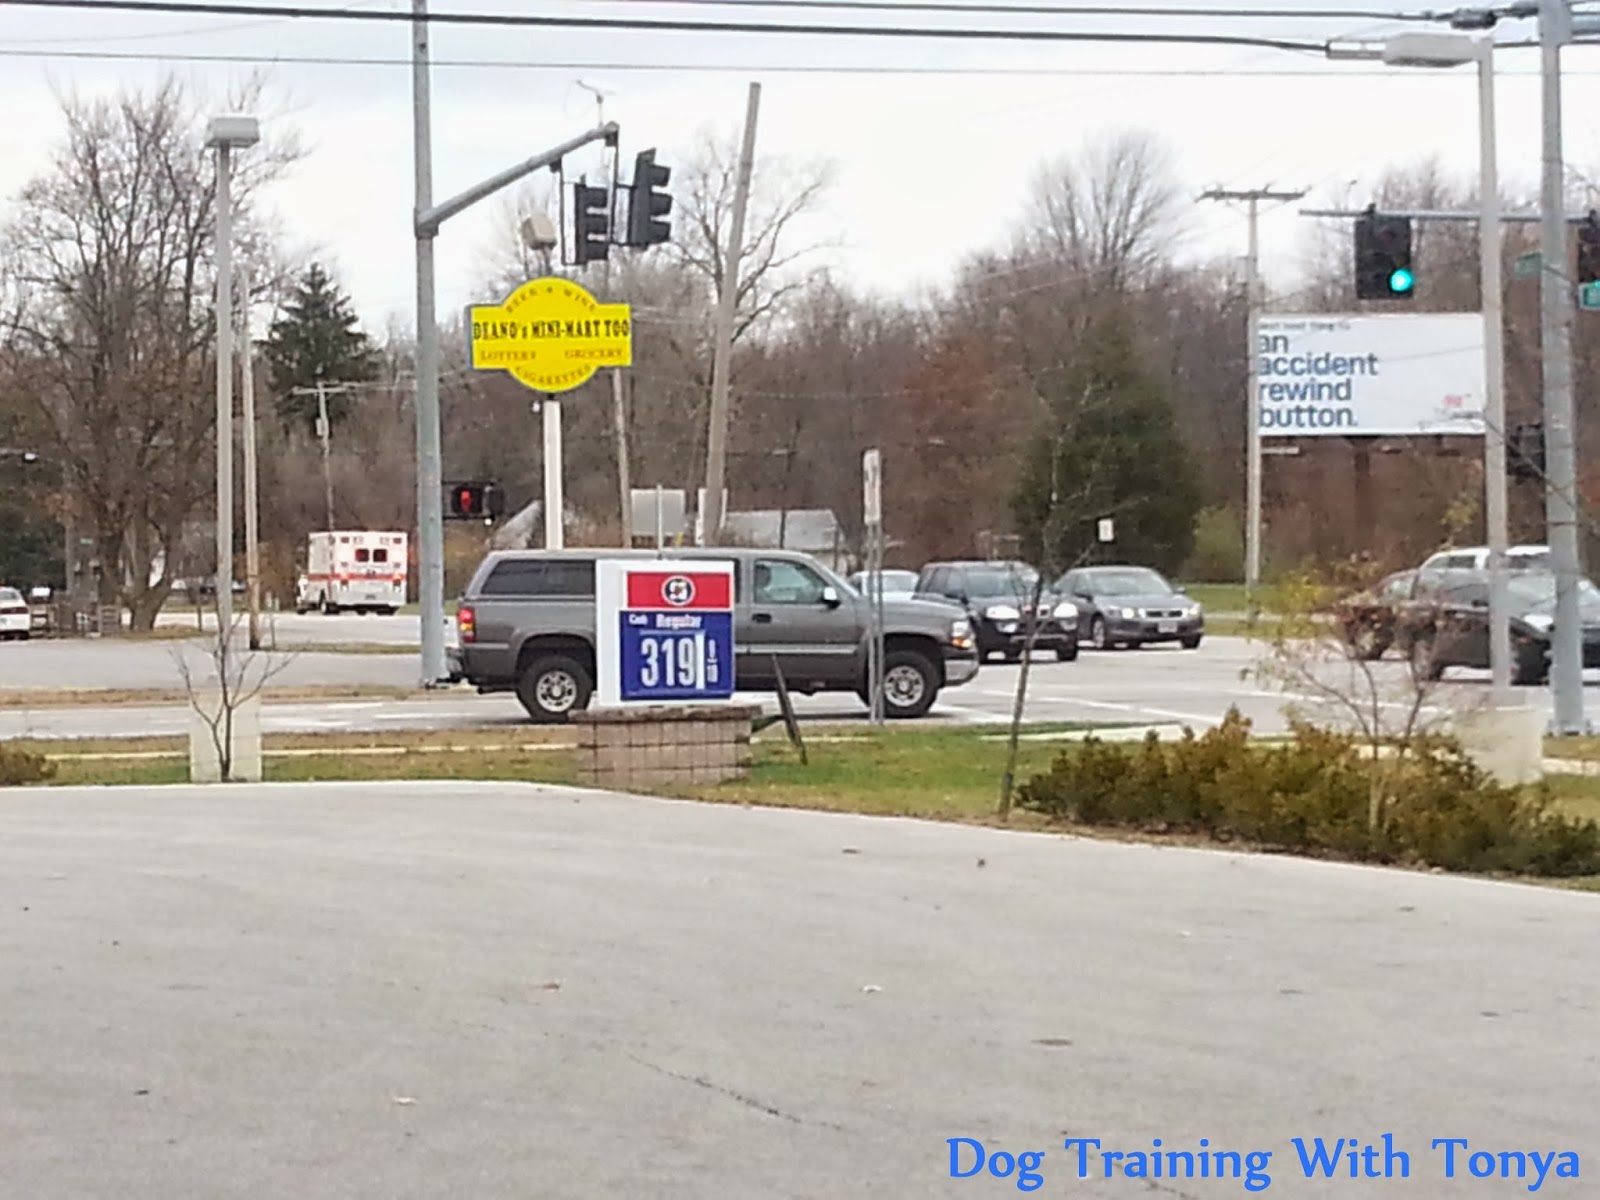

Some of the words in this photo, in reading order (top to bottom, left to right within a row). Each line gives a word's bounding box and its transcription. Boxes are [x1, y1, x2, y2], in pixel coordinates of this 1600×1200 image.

[531, 319, 601, 340] MINI-MART
[603, 319, 630, 338] TOO
[1259, 351, 1379, 376] accident
[1260, 378, 1352, 402] rewind
[656, 613, 702, 630] Regular
